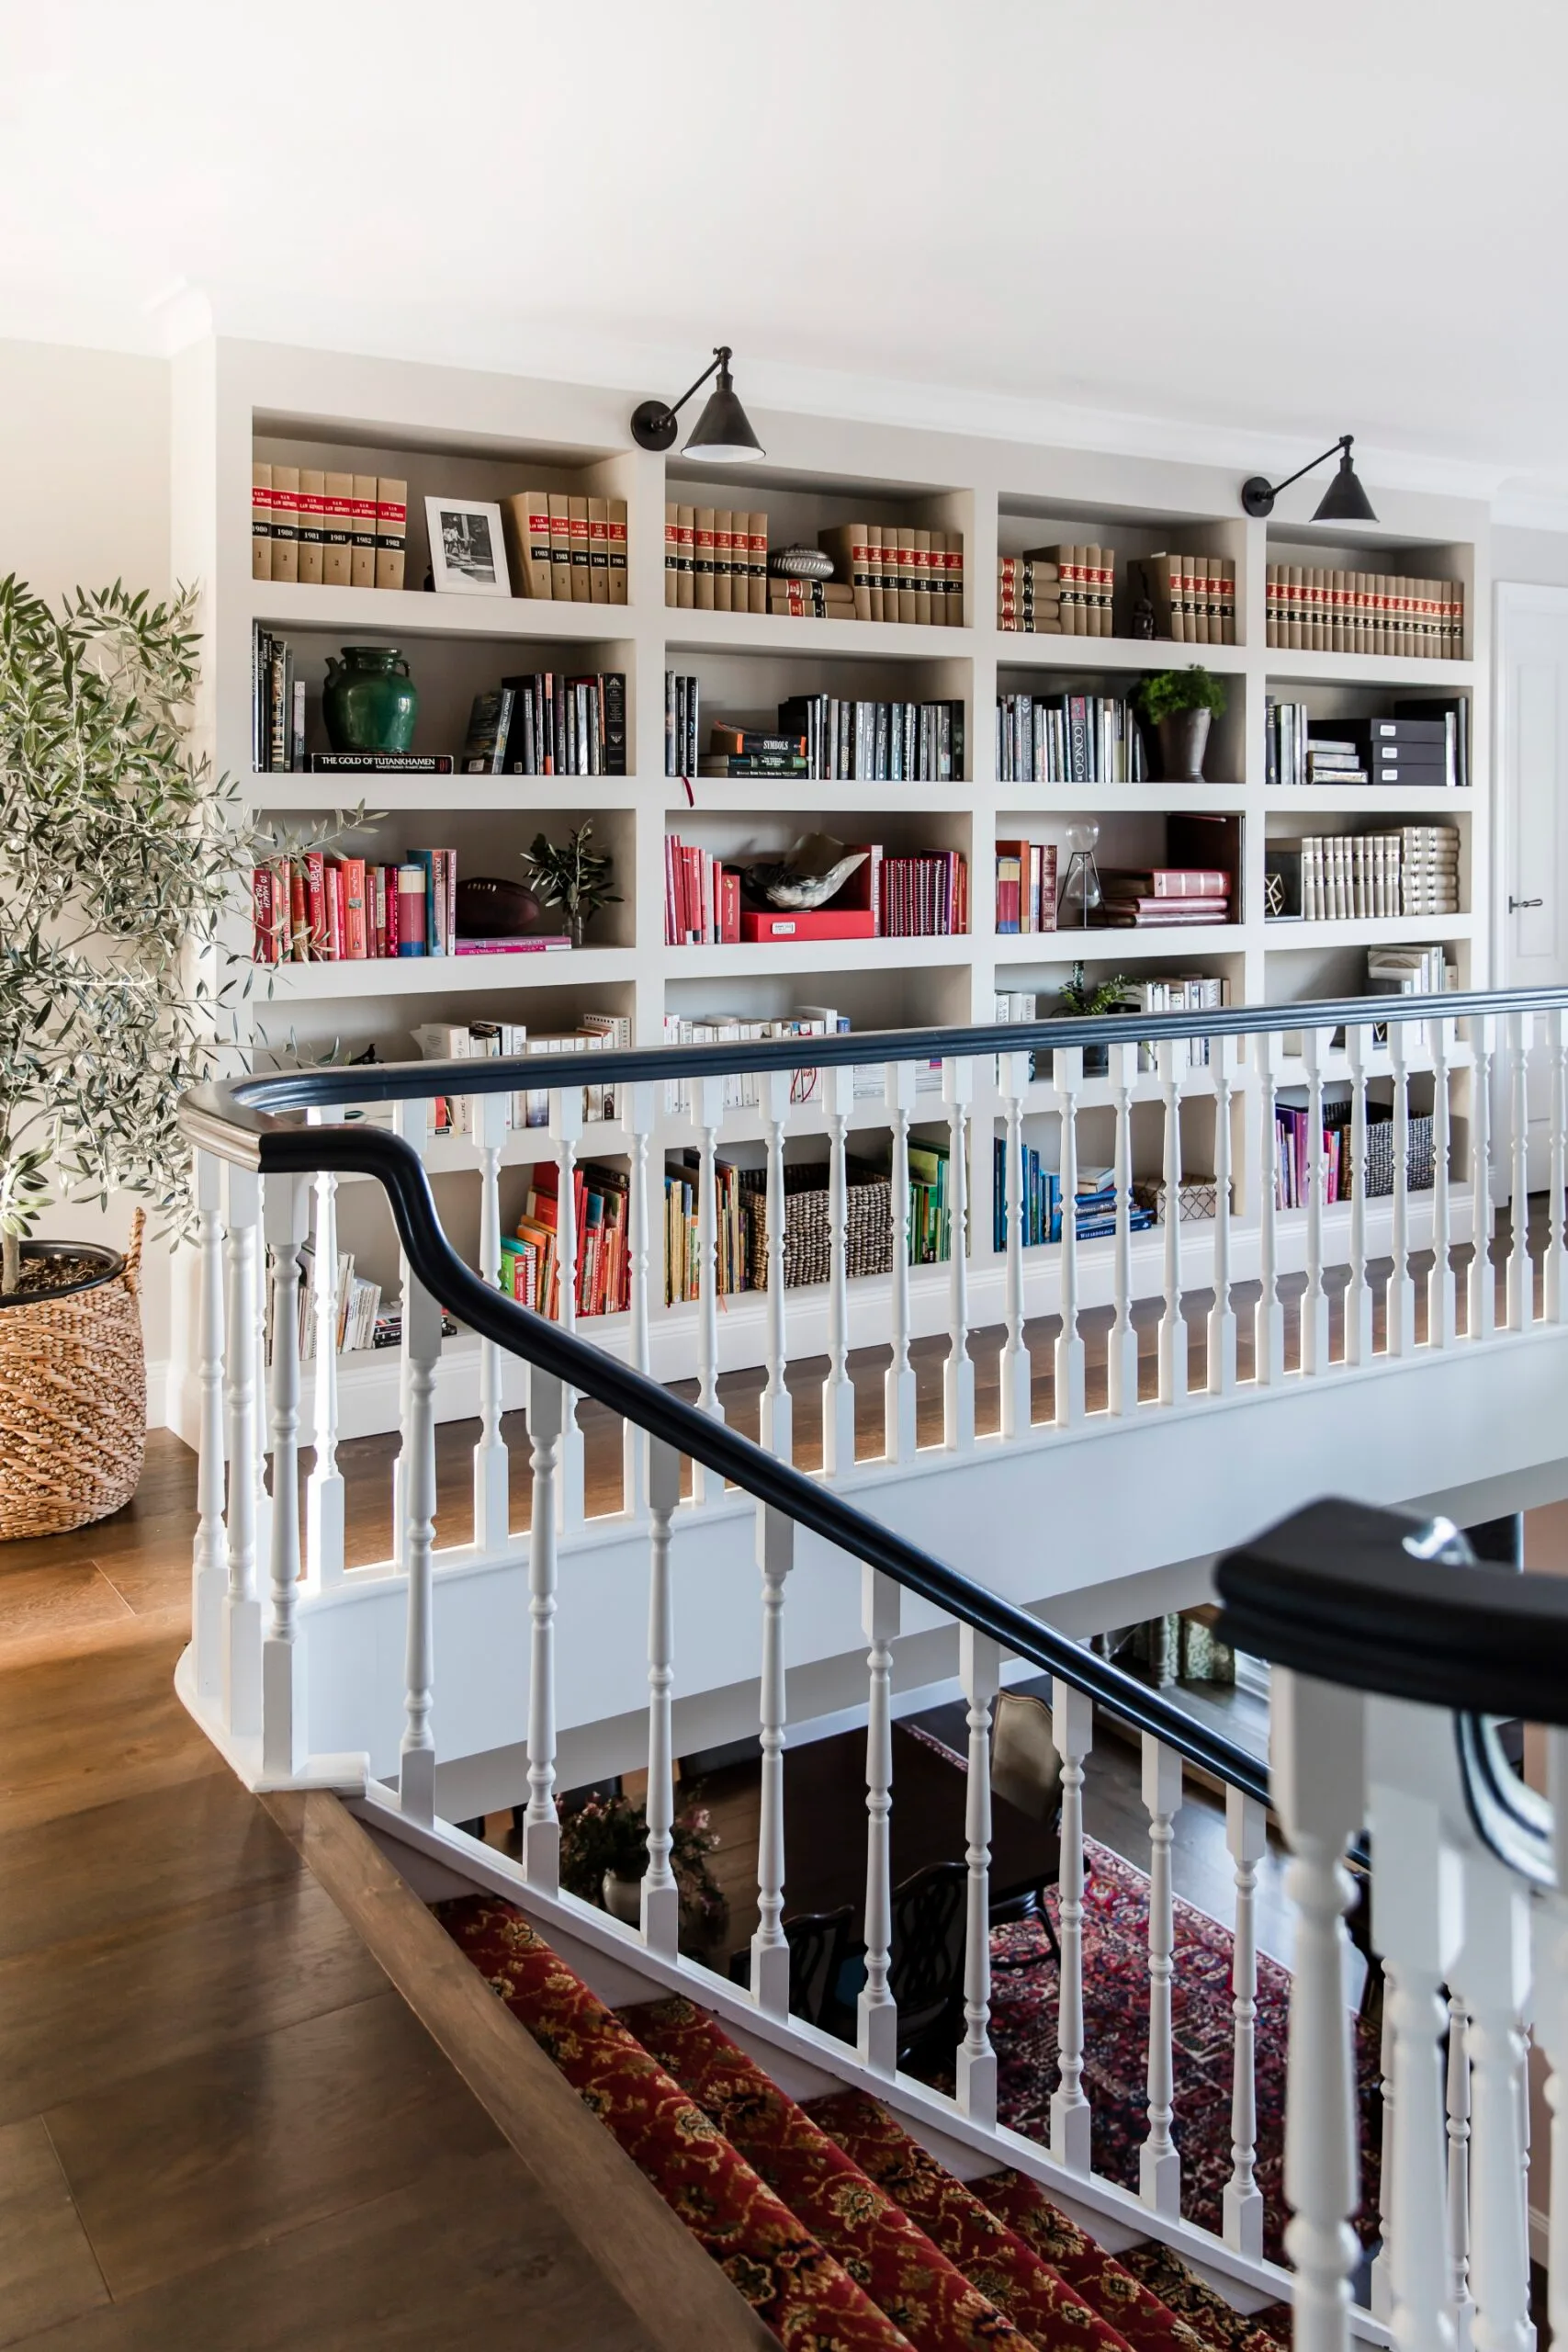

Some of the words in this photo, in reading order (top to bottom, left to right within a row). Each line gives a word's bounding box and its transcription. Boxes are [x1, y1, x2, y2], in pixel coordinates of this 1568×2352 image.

[304, 532, 320, 540] 1981
[763, 741, 788, 750] SYMBOLS
[1074, 727, 1085, 775] CONGO
[310, 865, 321, 893] Plante
[262, 886, 270, 908] MUCH
